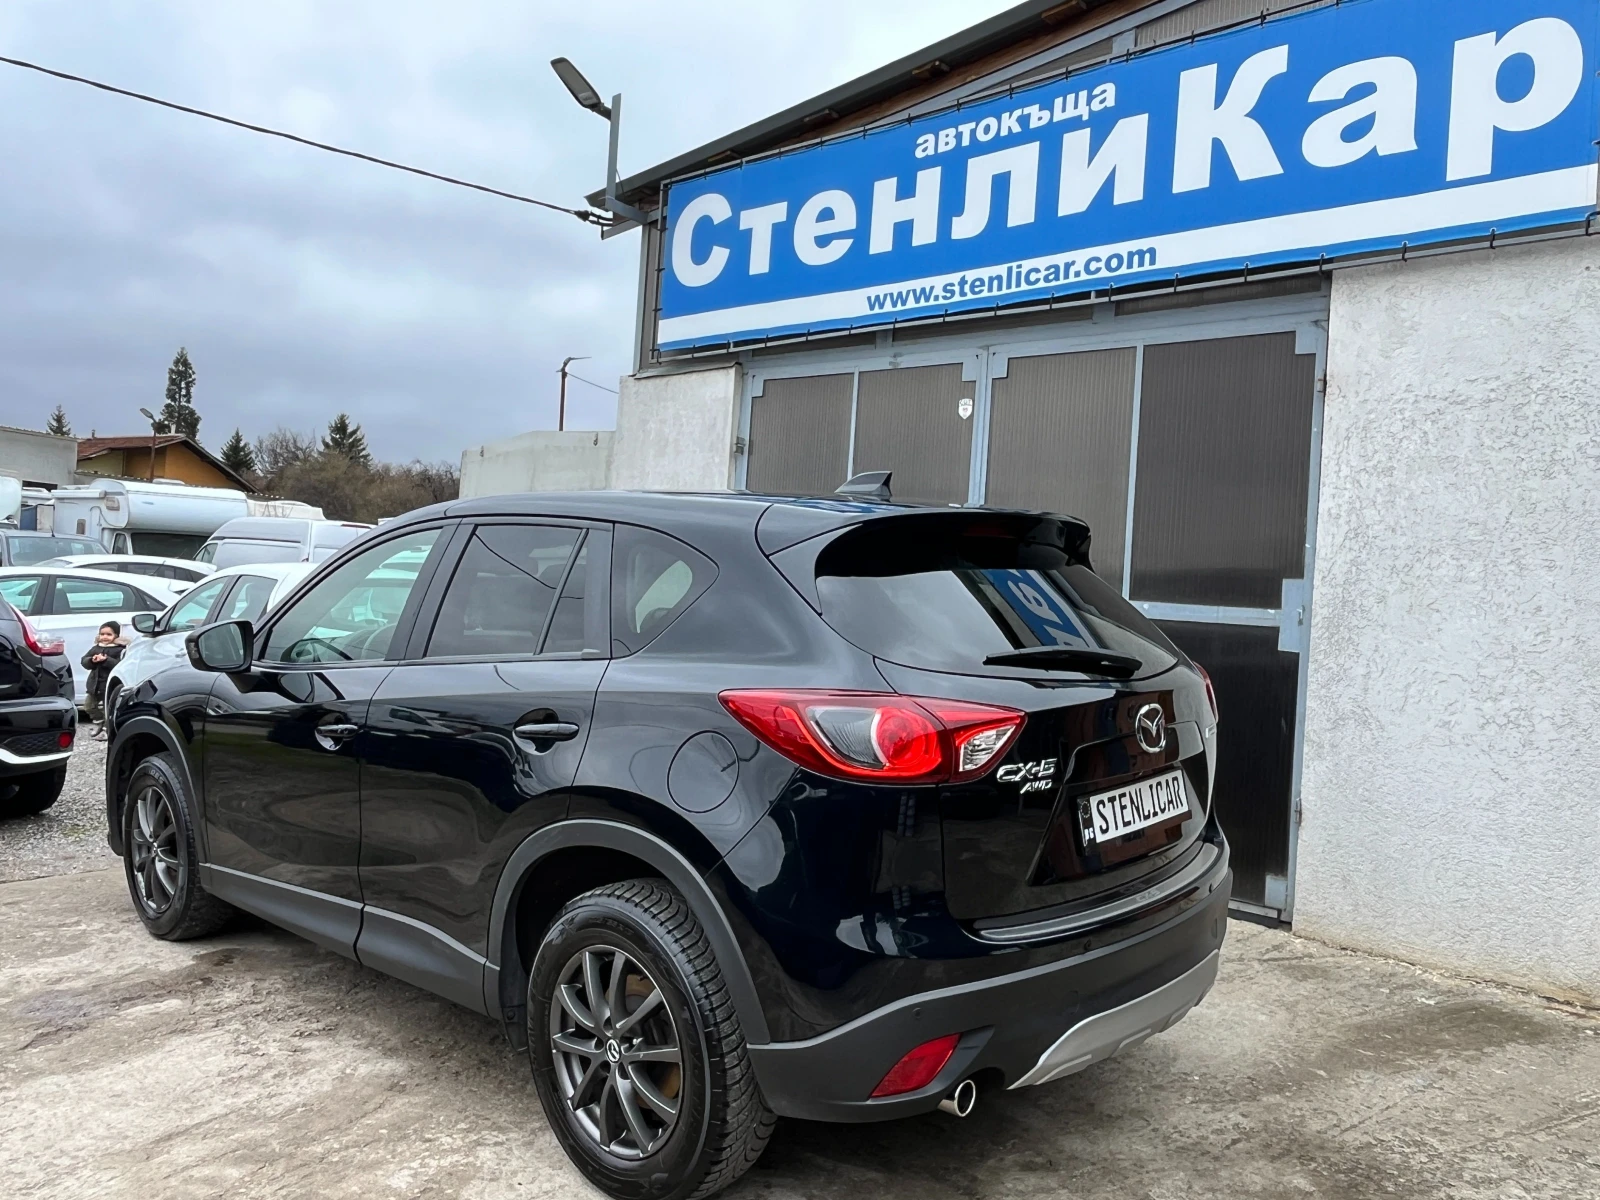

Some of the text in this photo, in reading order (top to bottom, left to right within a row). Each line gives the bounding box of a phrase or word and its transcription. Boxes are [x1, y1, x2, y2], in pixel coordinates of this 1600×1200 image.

[914, 82, 1116, 159] автокъща
[671, 17, 1584, 287] СтенлиКар
[866, 246, 1157, 311] www.stenlicar.com
[996, 757, 1058, 782] CX-5
[1019, 779, 1053, 794] AWD
[1096, 775, 1184, 835] STENLICAR
